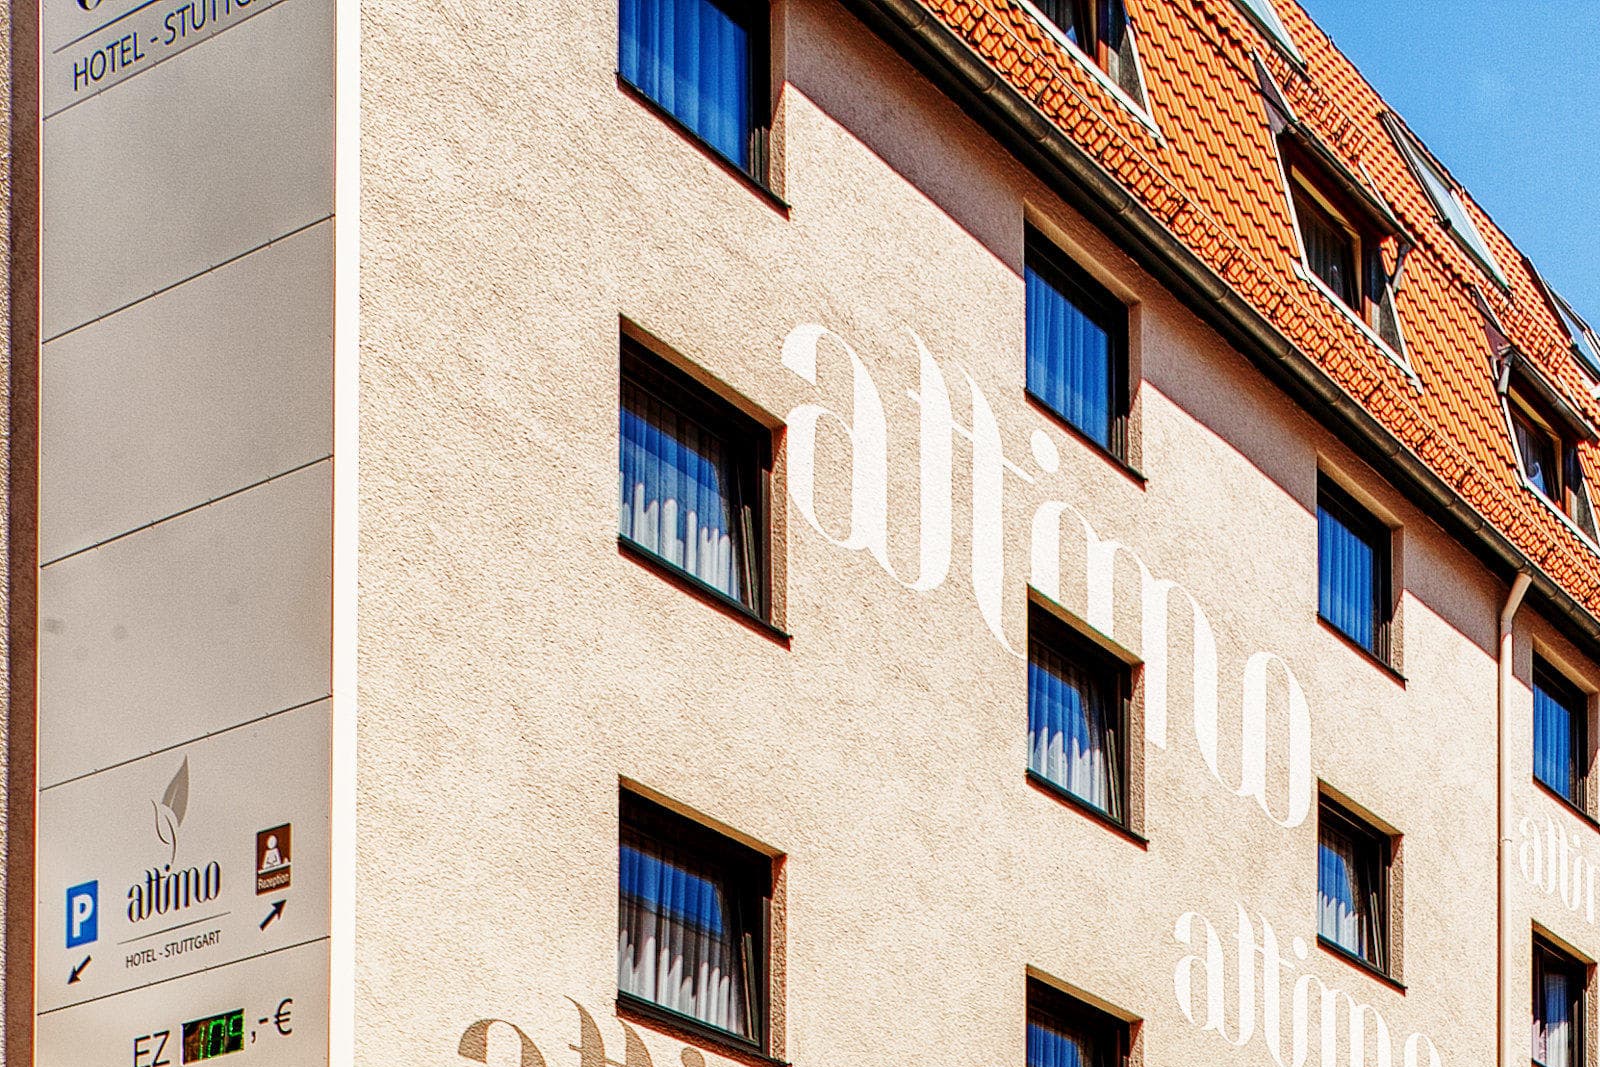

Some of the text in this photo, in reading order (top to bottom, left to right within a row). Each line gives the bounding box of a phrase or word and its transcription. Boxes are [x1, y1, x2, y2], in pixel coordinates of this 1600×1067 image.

[73, 32, 145, 91] HOTEL
[780, 323, 1312, 829] attimo
[73, 894, 94, 938] P
[127, 860, 221, 924] attimo
[125, 949, 157, 968] HOTEL
[165, 929, 221, 959] STUTTGART
